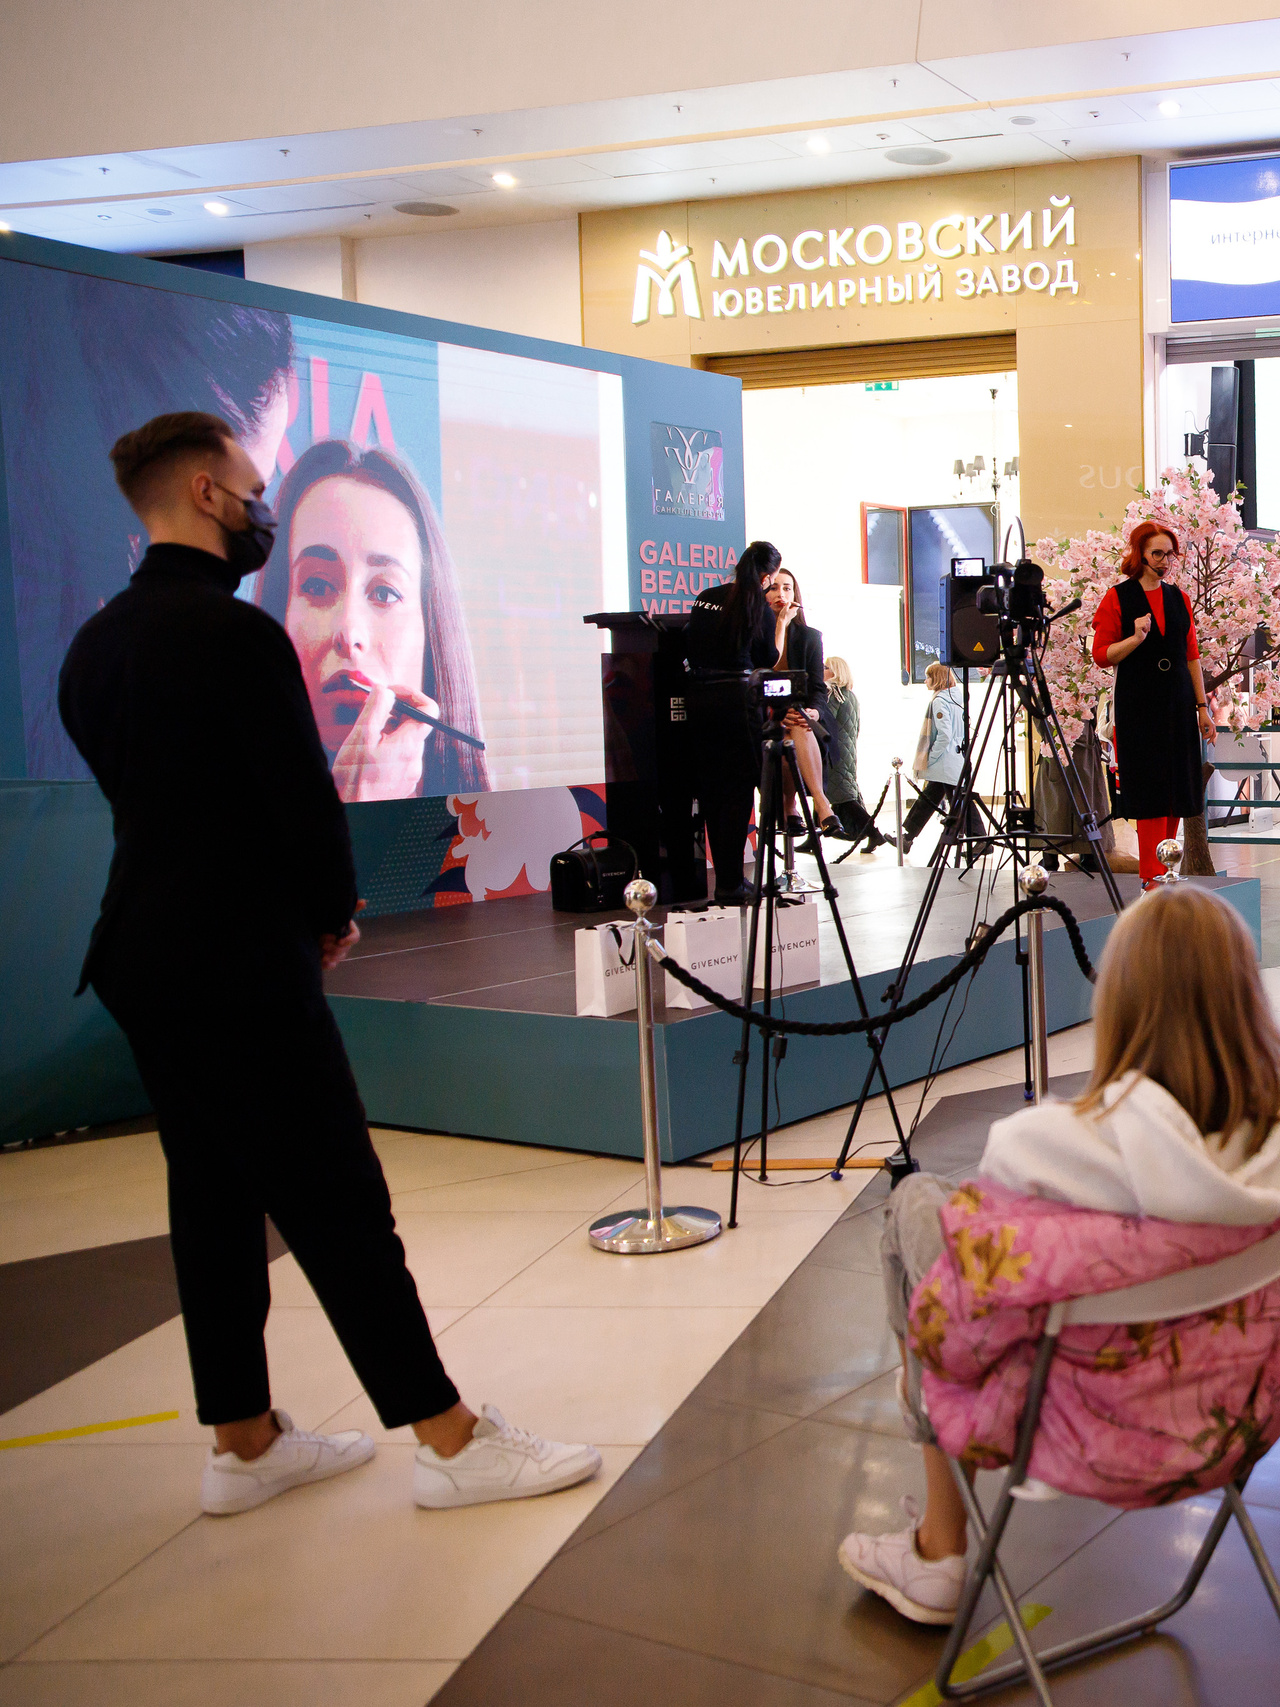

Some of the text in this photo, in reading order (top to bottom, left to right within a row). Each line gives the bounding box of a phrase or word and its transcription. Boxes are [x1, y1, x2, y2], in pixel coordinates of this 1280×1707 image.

[711, 194, 1075, 279] МОСКОВСКИЙ
[712, 258, 1079, 318] ЮВЕЛИРНЫЙ ЗАВОД
[639, 539, 738, 570] GALERIA
[771, 938, 817, 954] GIVENCHY
[690, 953, 739, 971] GIVENCHY
